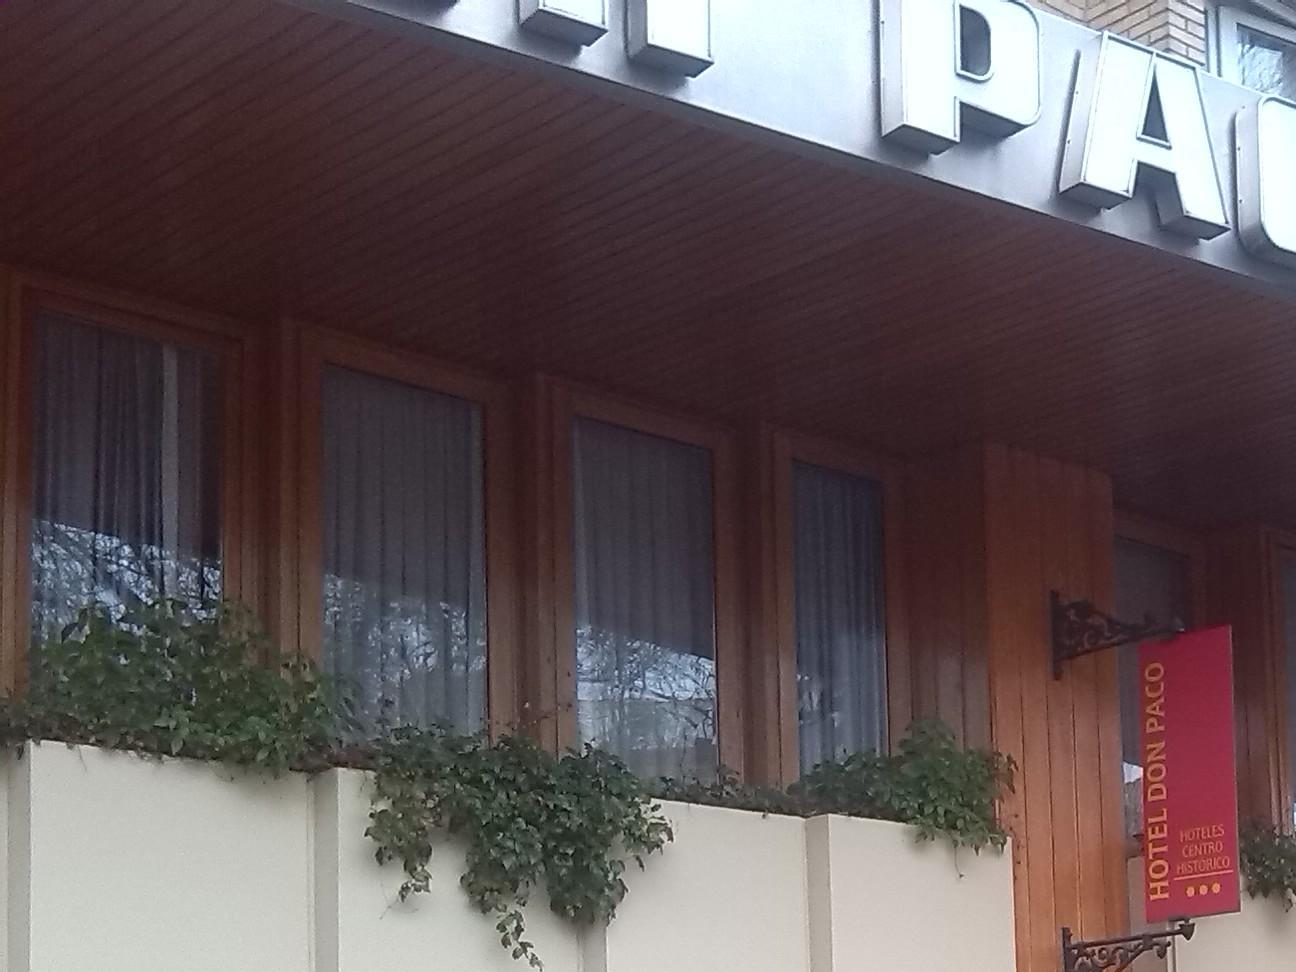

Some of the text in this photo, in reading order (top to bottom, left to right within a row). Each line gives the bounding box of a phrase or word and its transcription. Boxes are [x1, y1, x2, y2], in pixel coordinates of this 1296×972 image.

[1145, 662, 1169, 900] HOTEL DON PACO
[1180, 824, 1224, 842] HOTELES
[1182, 841, 1223, 857] CENTRO
